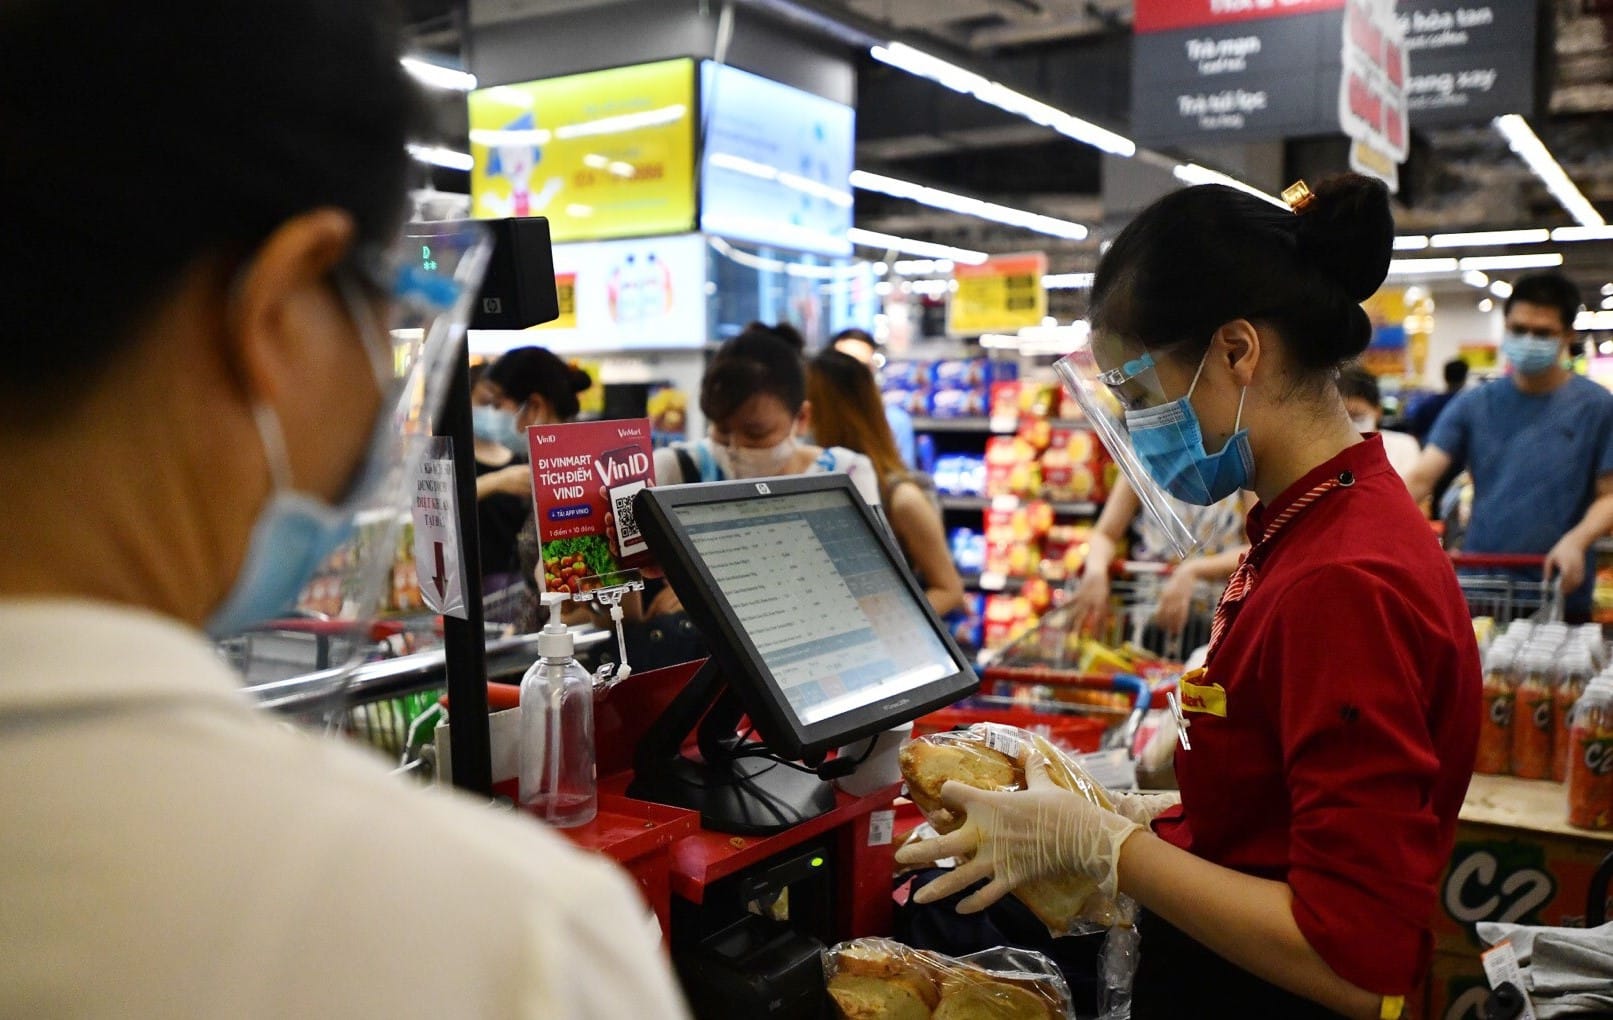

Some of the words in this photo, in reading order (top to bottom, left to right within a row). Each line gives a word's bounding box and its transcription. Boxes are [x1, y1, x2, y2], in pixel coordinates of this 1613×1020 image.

[536, 434, 556, 445] VinID
[617, 428, 641, 438] VinMart
[538, 458, 550, 470] ĐI
[550, 455, 592, 468] VINMART
[594, 452, 649, 487] VinID
[540, 471, 565, 486] TÍCH
[552, 485, 584, 500] VINID
[1446, 851, 1553, 924] C2
